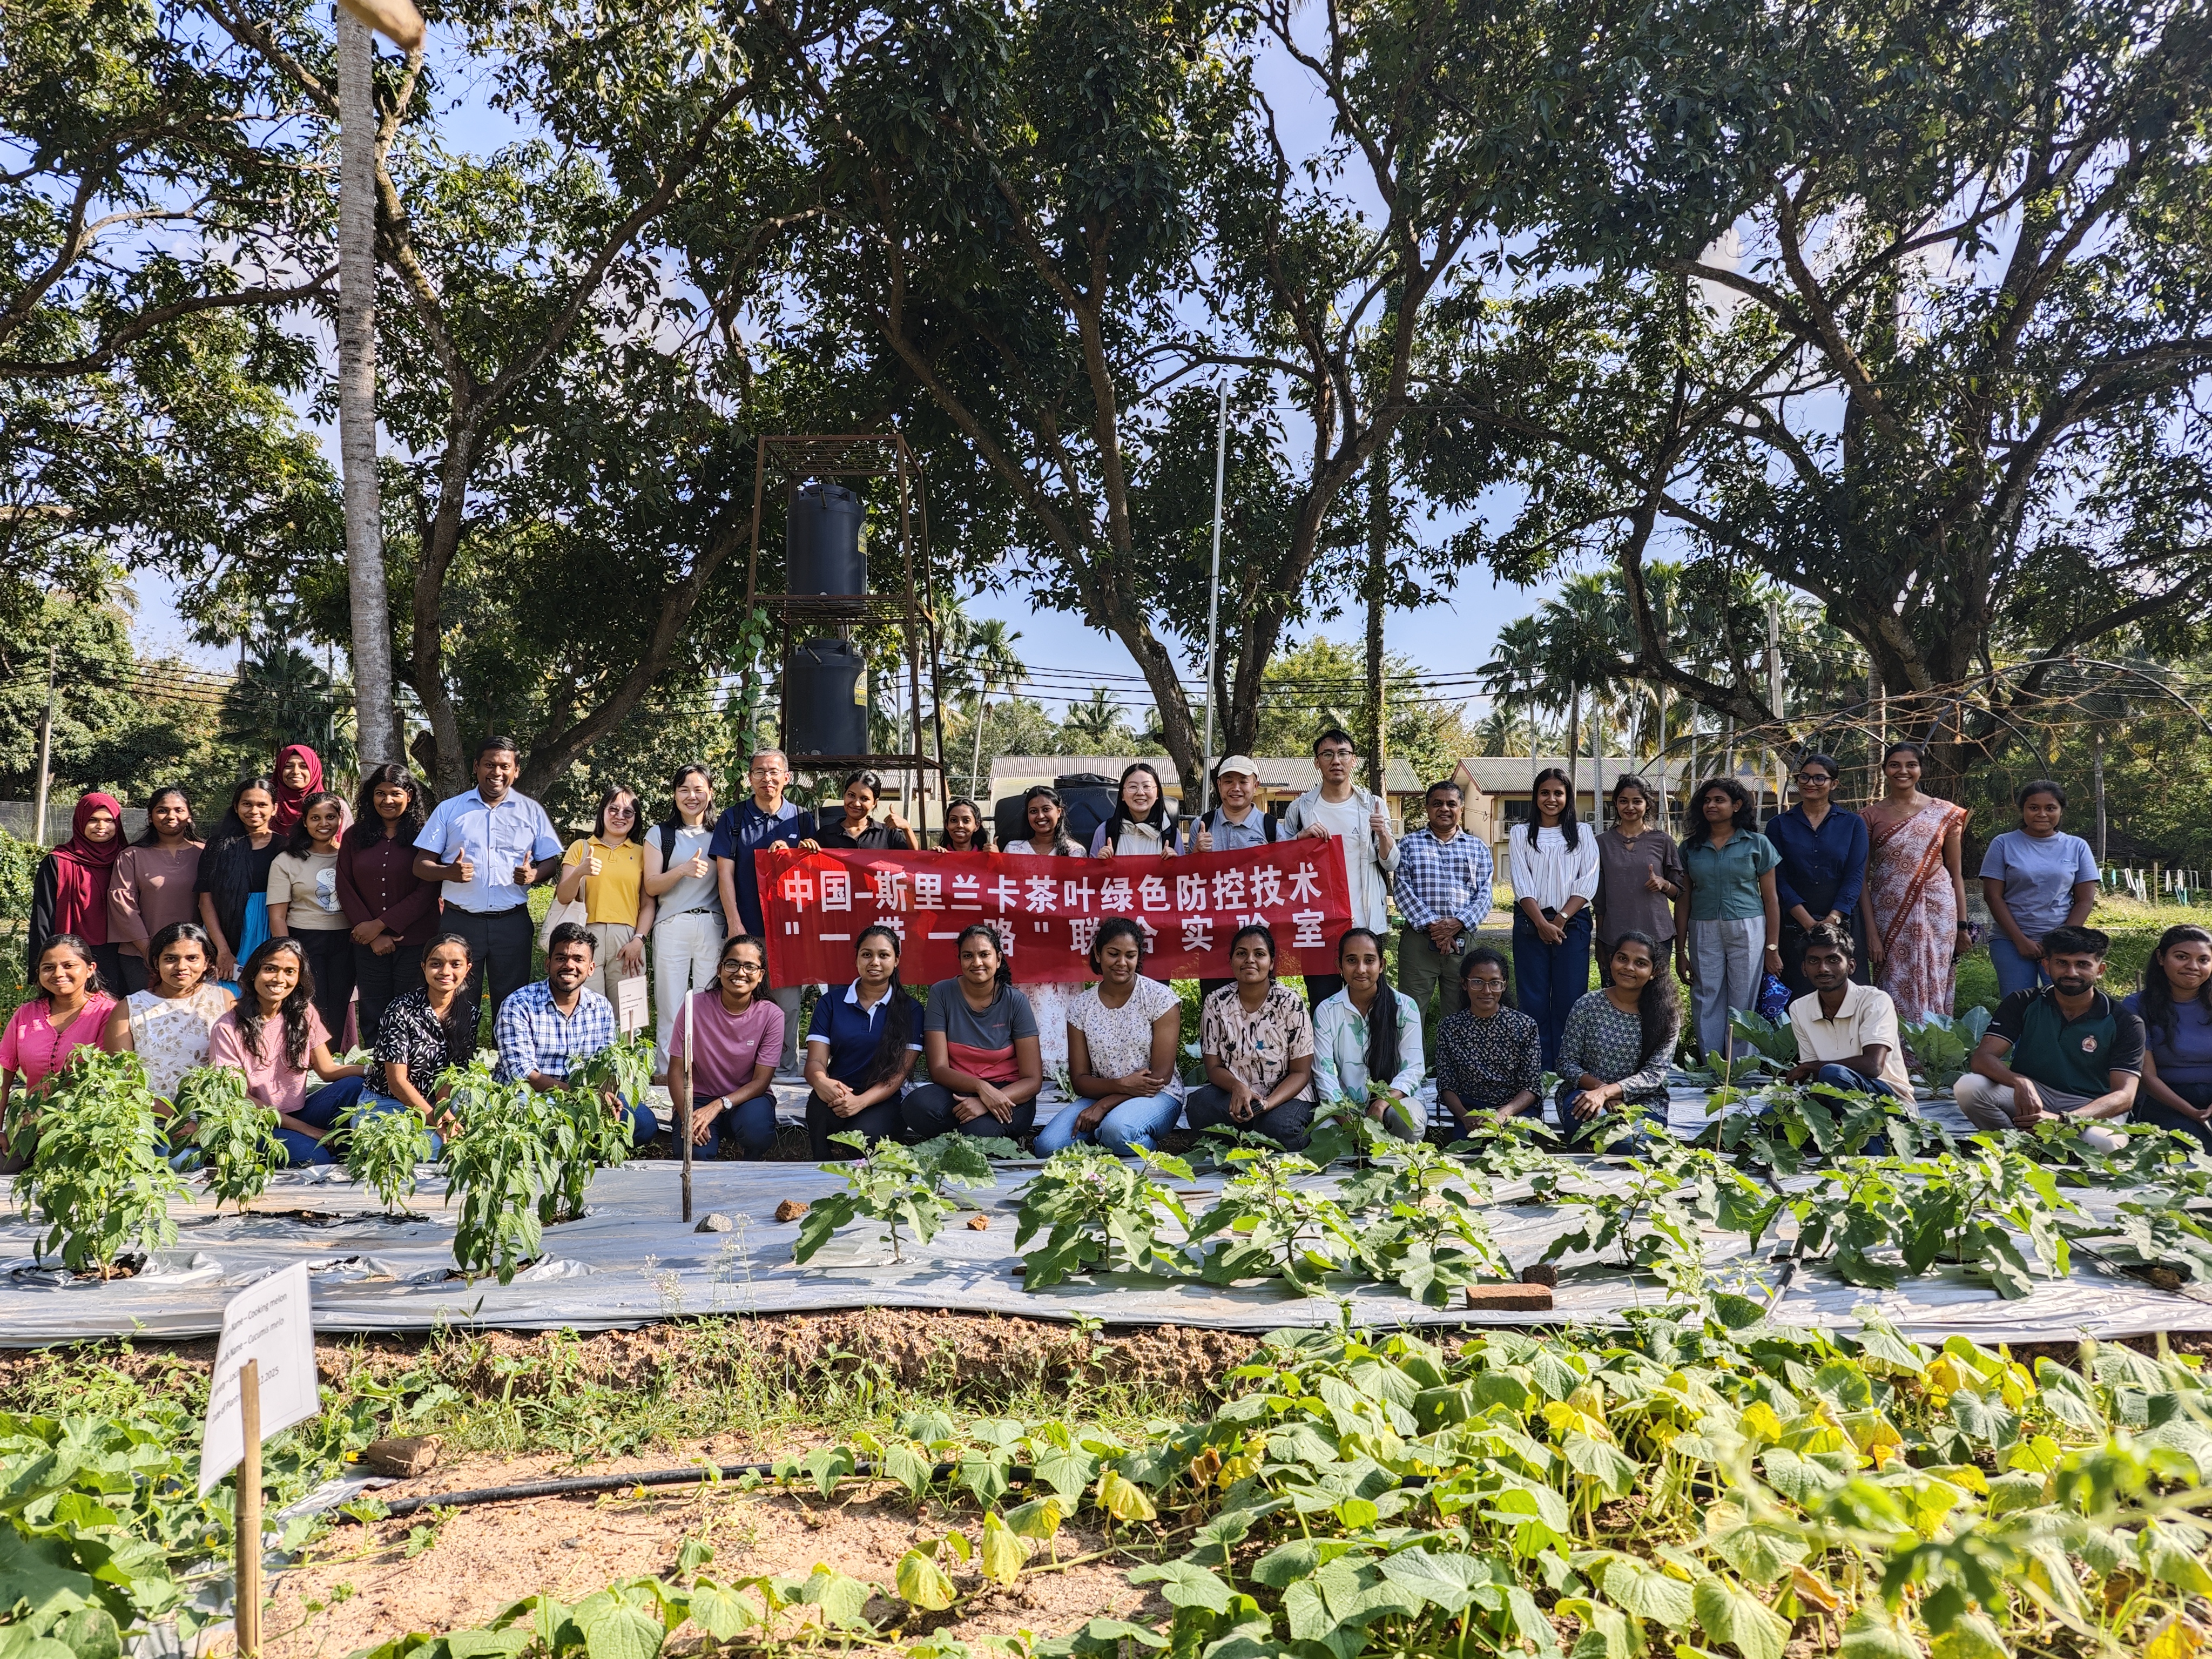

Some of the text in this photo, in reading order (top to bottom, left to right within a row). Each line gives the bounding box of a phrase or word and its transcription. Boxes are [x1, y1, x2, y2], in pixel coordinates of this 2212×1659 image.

[248, 1303, 269, 1319] Cooking
[269, 1293, 287, 1307] melon
[248, 1324, 269, 1344] Cucumis
[269, 1317, 284, 1332] melo
[230, 1370, 239, 1382] Loca
[226, 1393, 241, 1410] Planti
